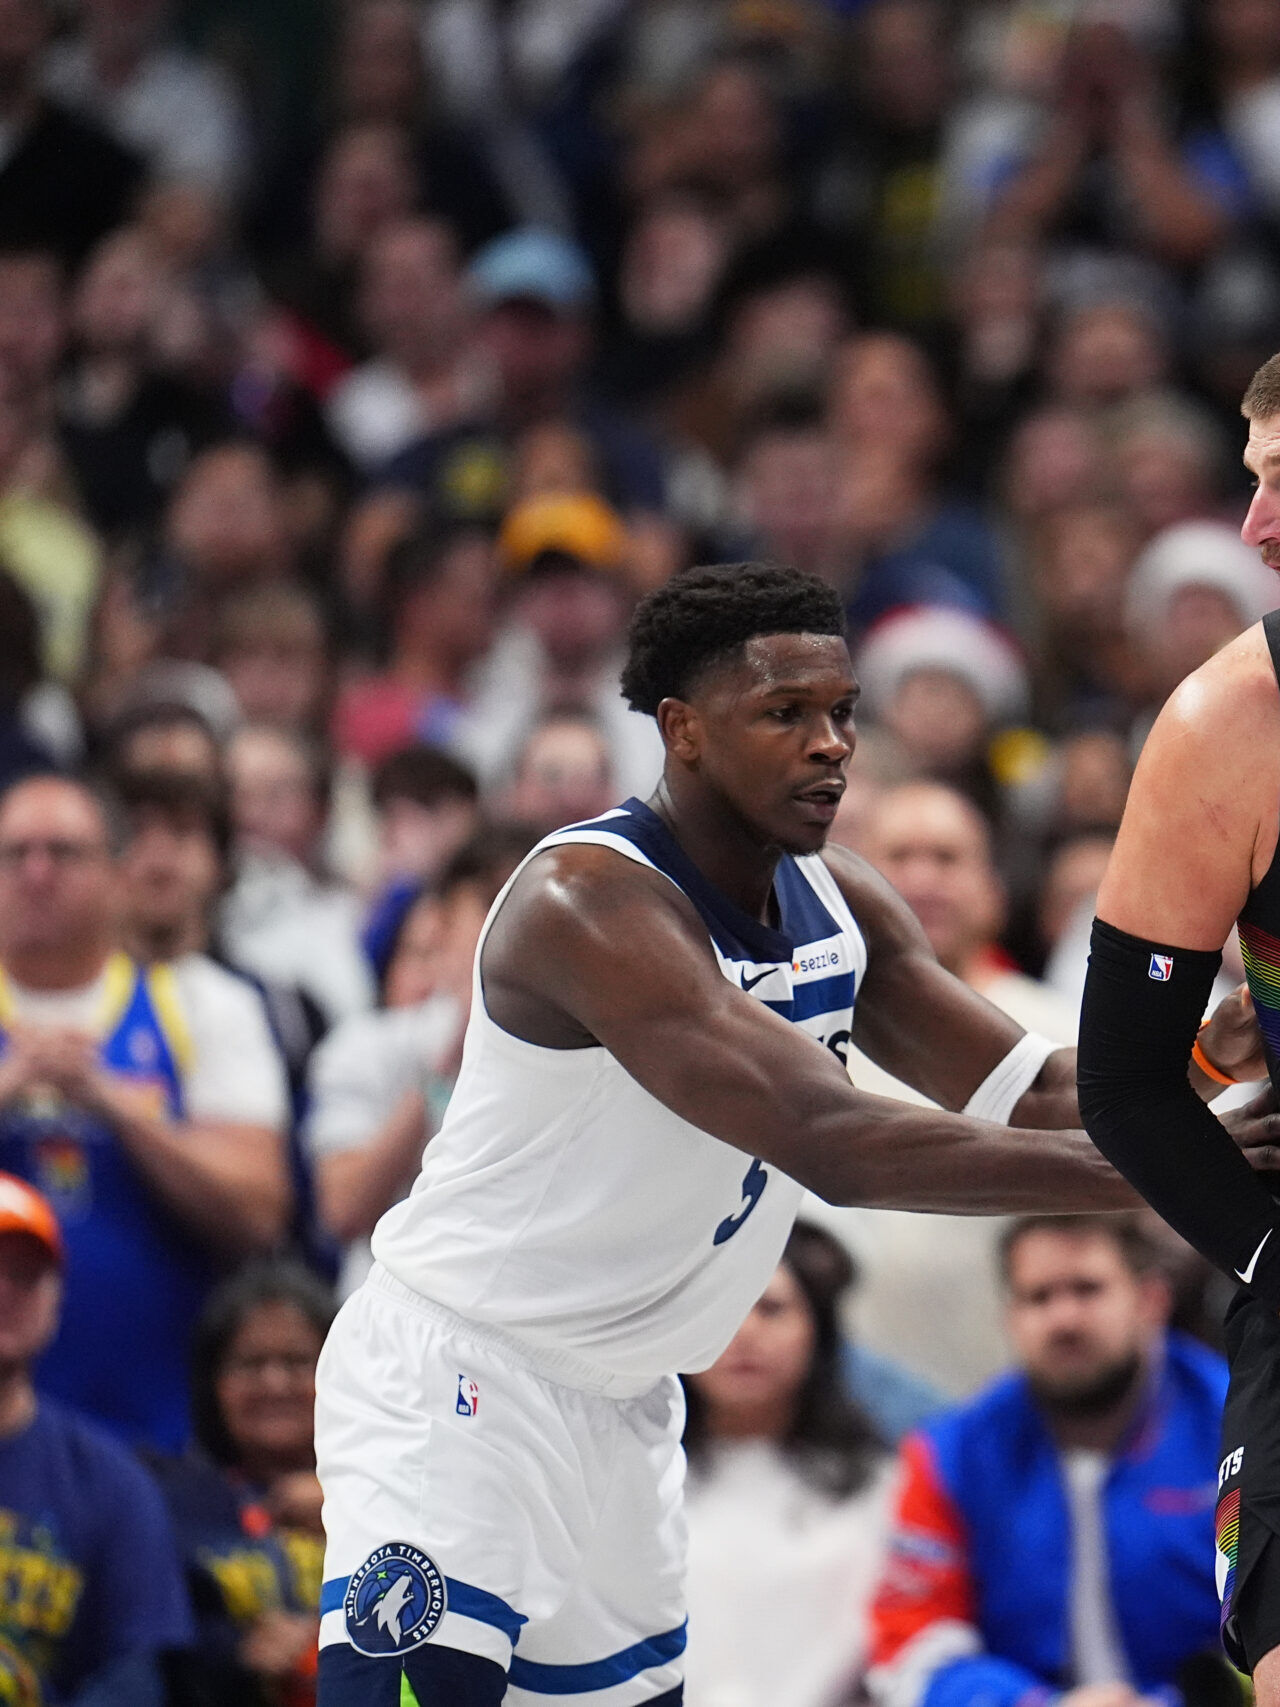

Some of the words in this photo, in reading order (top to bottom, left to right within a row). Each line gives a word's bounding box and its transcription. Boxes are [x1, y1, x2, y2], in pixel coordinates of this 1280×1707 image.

[800, 949, 839, 972] sezzle
[345, 1546, 392, 1618] MINNESOTA
[399, 1545, 442, 1640] TIMBERWOLVES
